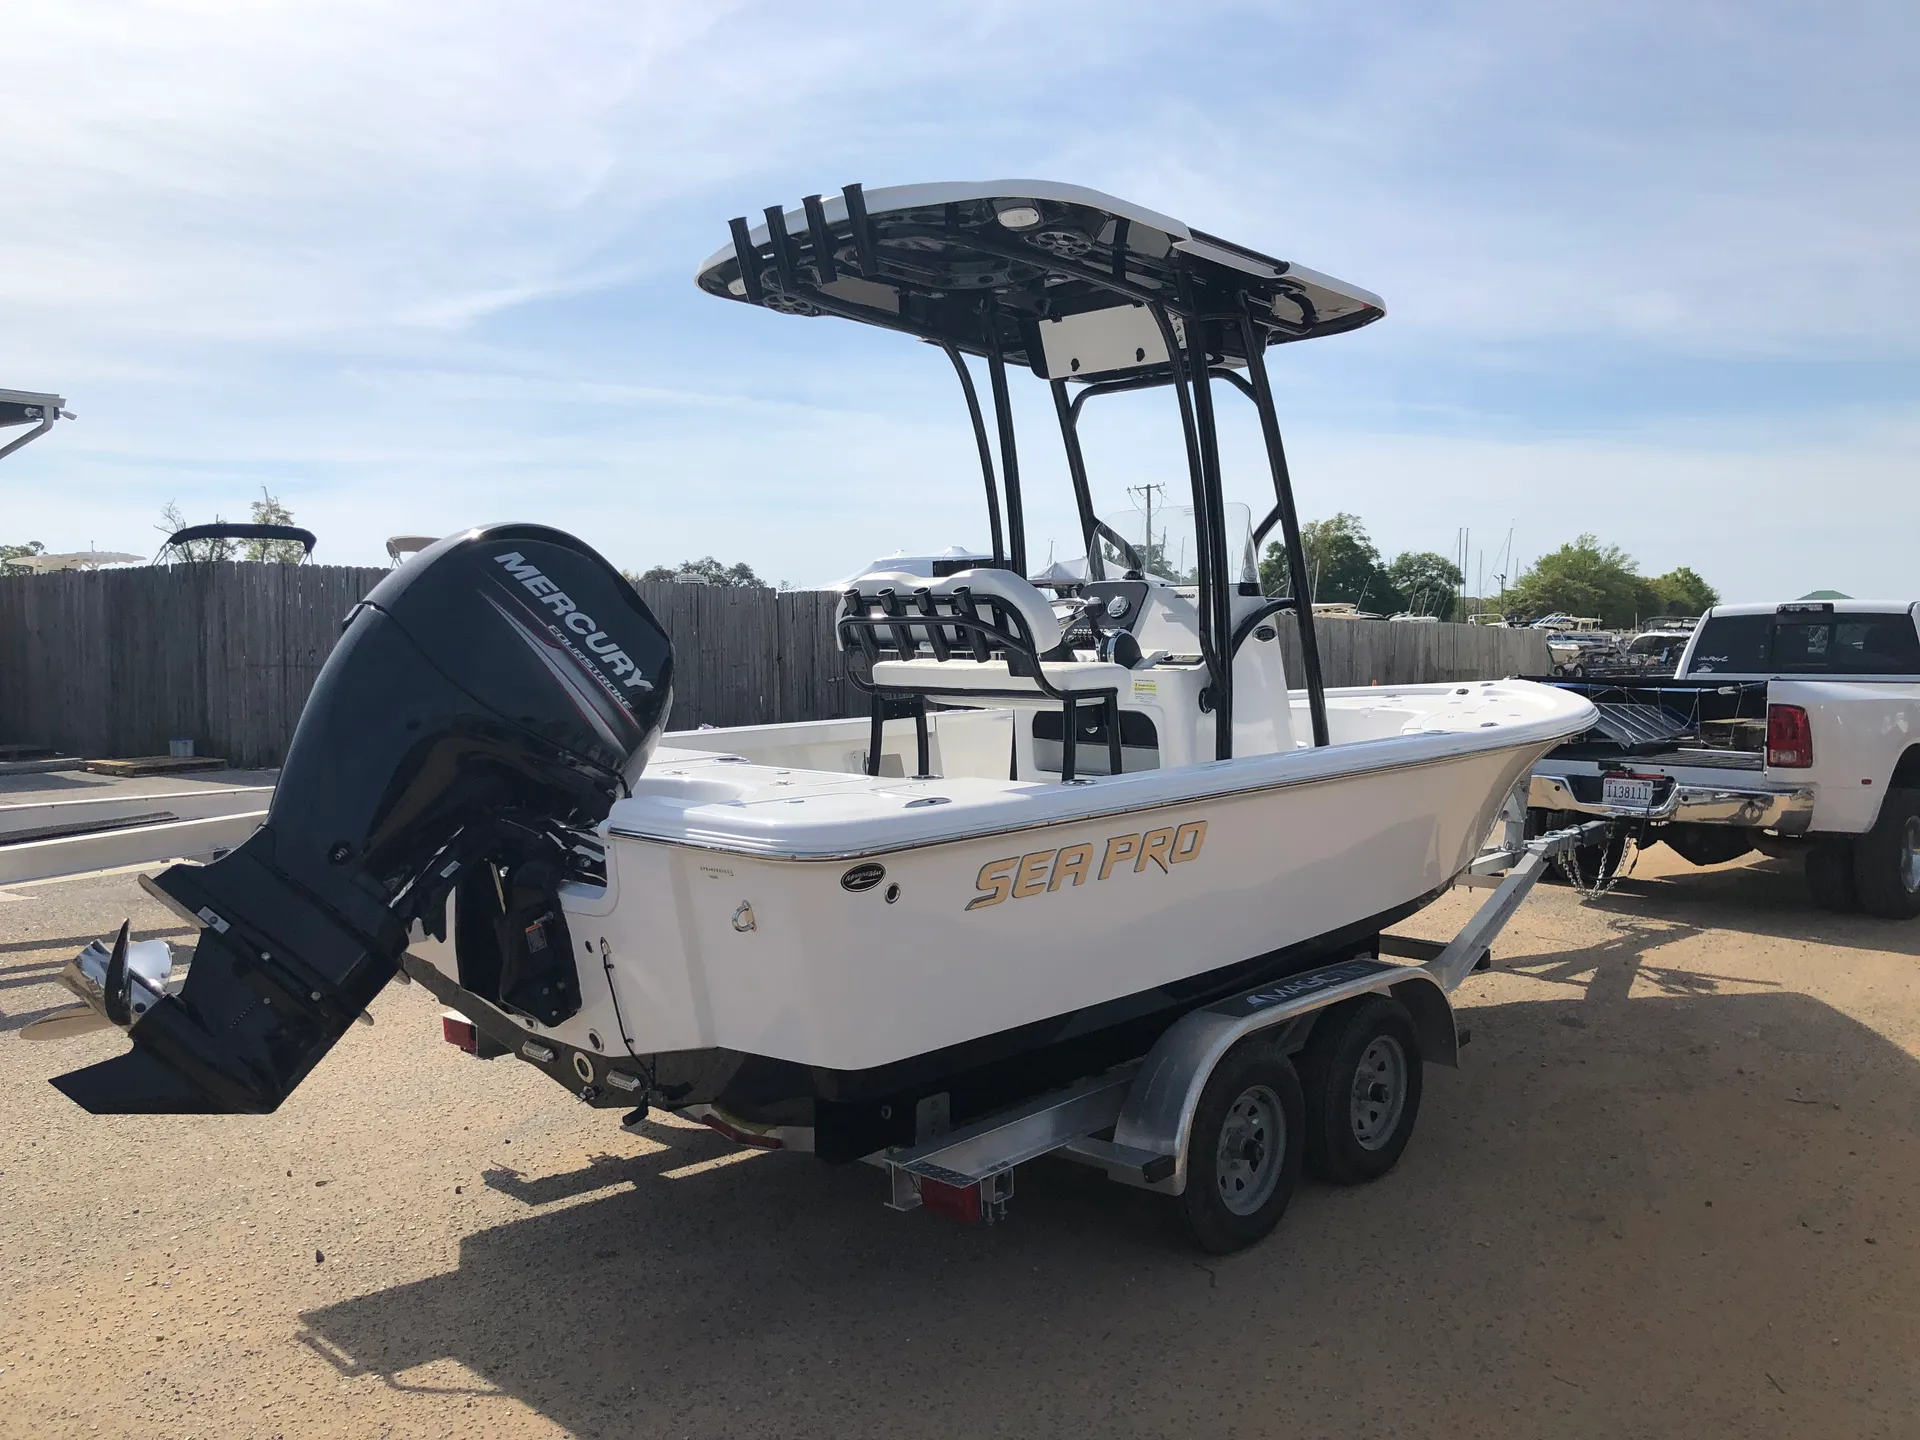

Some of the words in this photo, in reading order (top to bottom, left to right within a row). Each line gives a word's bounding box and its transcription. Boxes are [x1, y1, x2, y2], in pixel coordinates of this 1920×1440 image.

[494, 551, 654, 692] MERCURY
[547, 624, 633, 710] FOURSTROKE
[964, 842, 1094, 911] SEA
[1097, 820, 1208, 881] PRO
